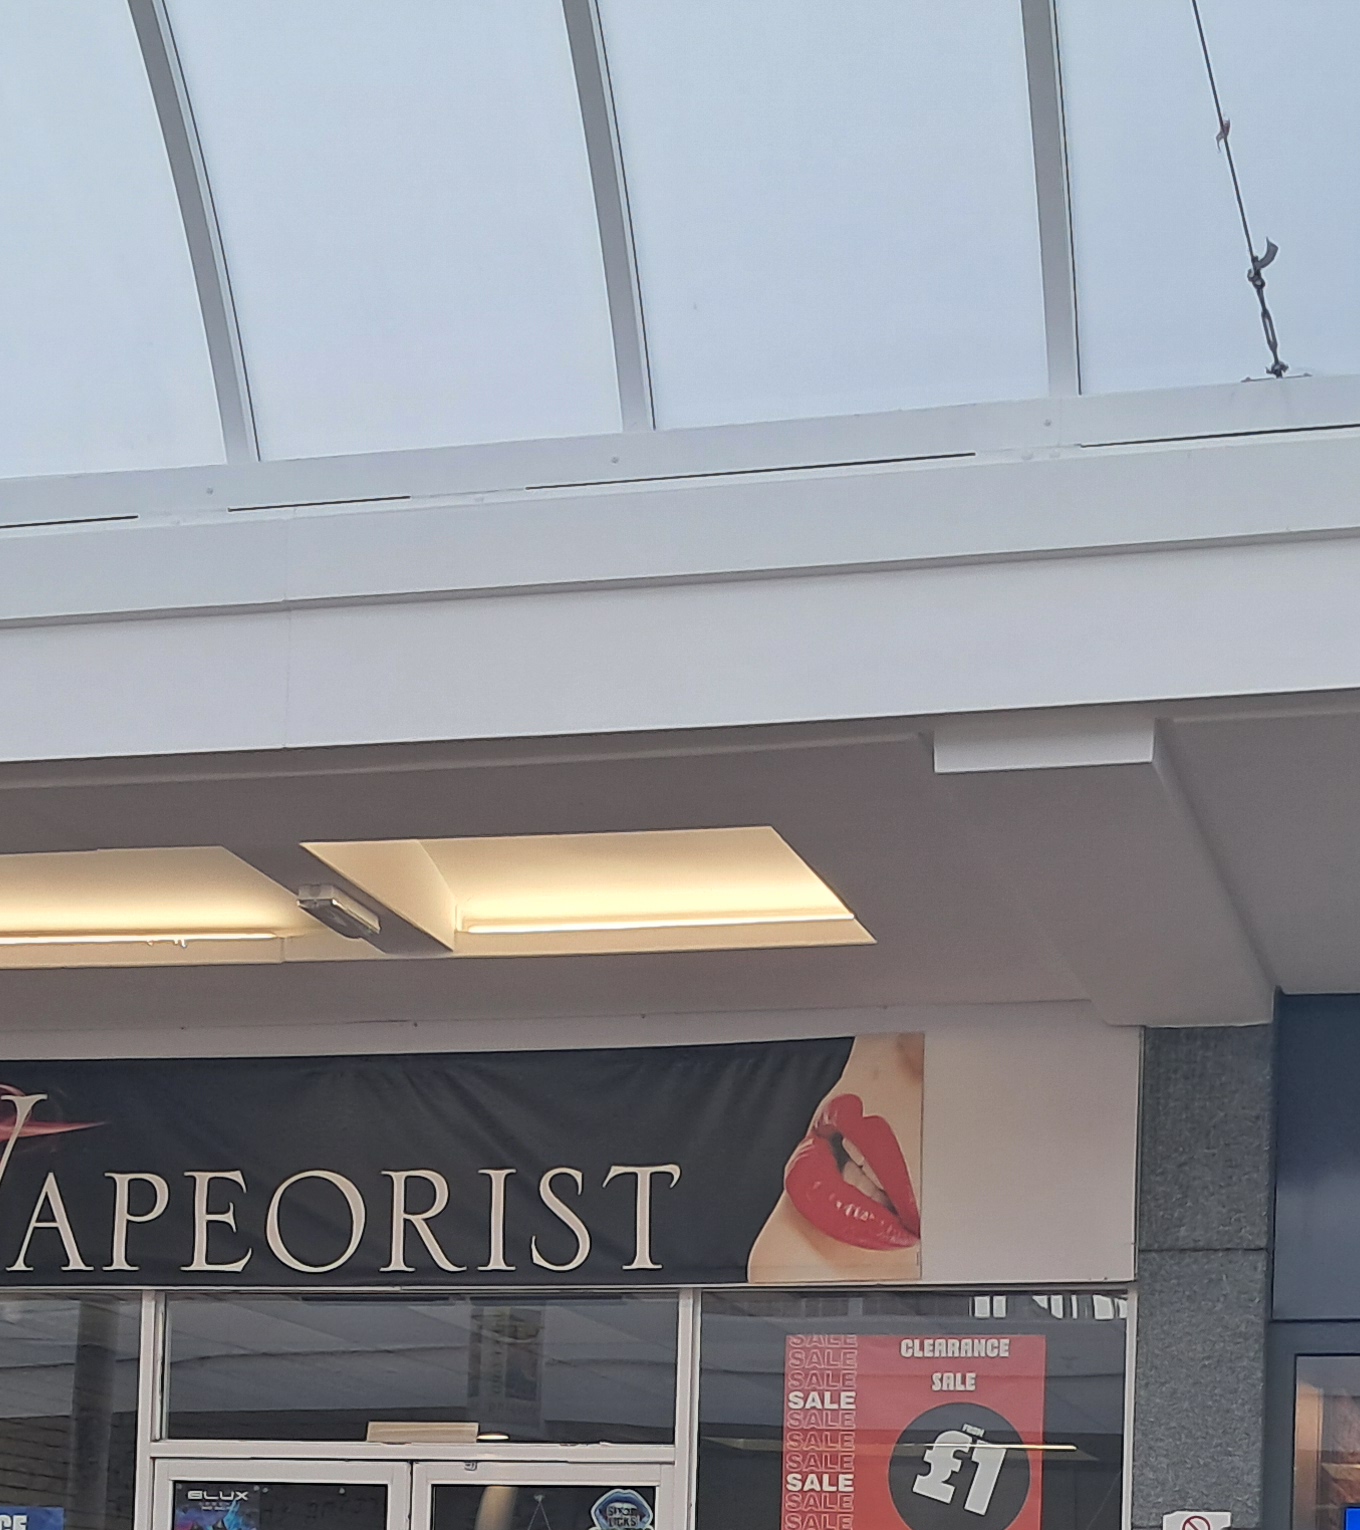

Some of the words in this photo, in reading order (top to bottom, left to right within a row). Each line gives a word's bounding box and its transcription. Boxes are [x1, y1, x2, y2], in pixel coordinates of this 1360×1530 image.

[900, 1338, 1010, 1357] CLEARANCE
[789, 1350, 857, 1369] SALE
[788, 1370, 857, 1390] SALE
[931, 1372, 976, 1392] SALE
[788, 1391, 856, 1410] SALE
[787, 1411, 856, 1430] SALE
[786, 1432, 856, 1451] SALE
[786, 1453, 855, 1472] SALE
[786, 1473, 855, 1492] SALE
[912, 1430, 1007, 1516] £1
[785, 1493, 854, 1512] SALE
